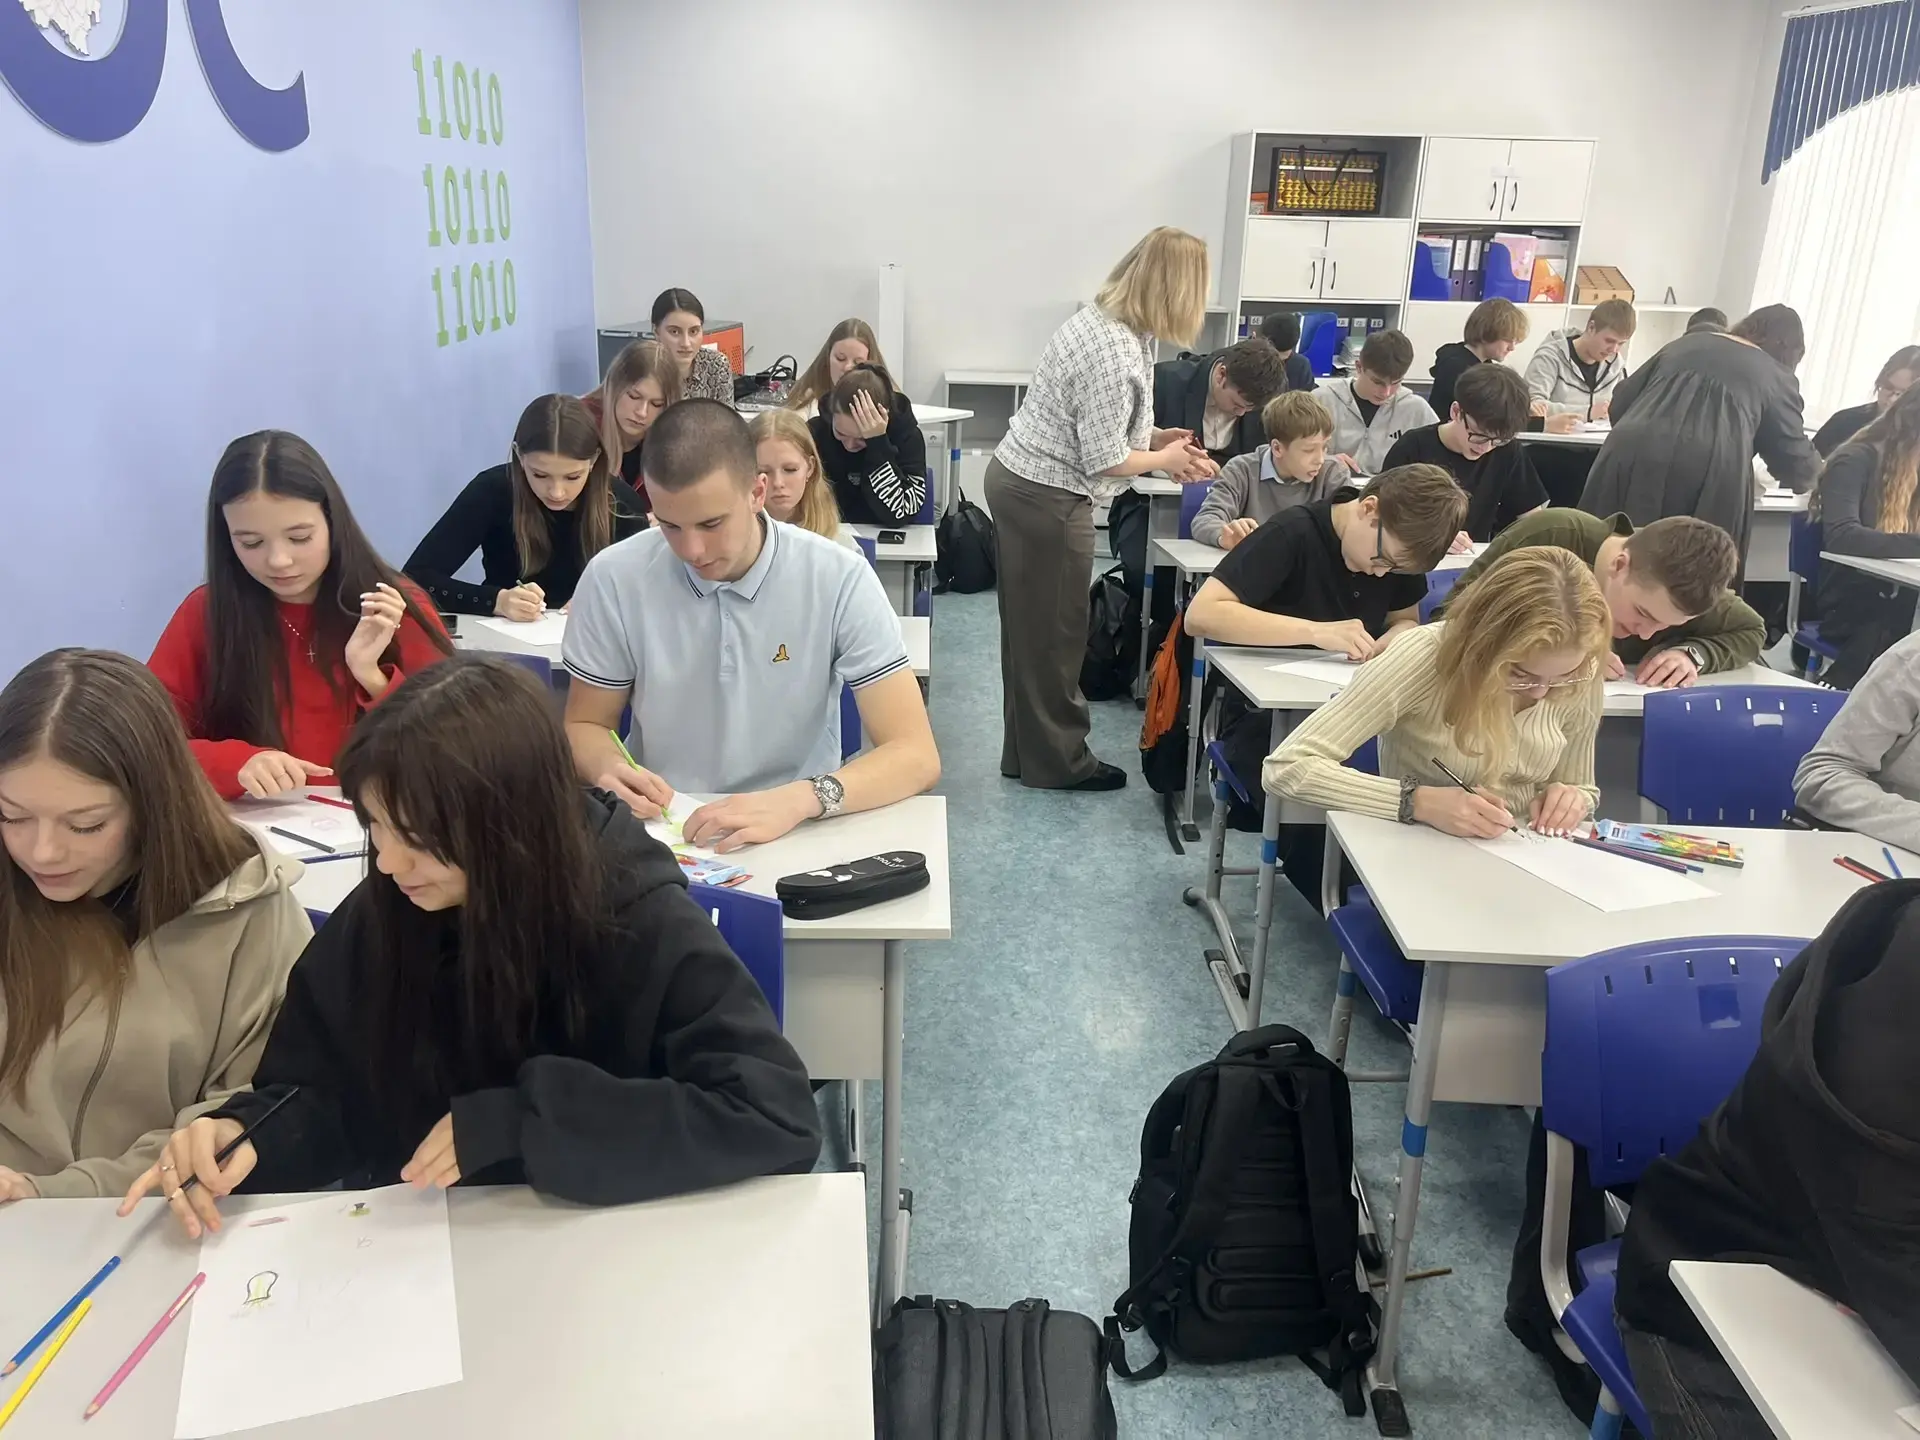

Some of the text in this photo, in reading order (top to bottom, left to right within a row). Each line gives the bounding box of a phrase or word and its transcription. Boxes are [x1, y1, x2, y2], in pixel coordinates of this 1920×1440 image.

[412, 47, 504, 147] 11010
[422, 163, 511, 247] 10110
[431, 257, 517, 348] 11010
